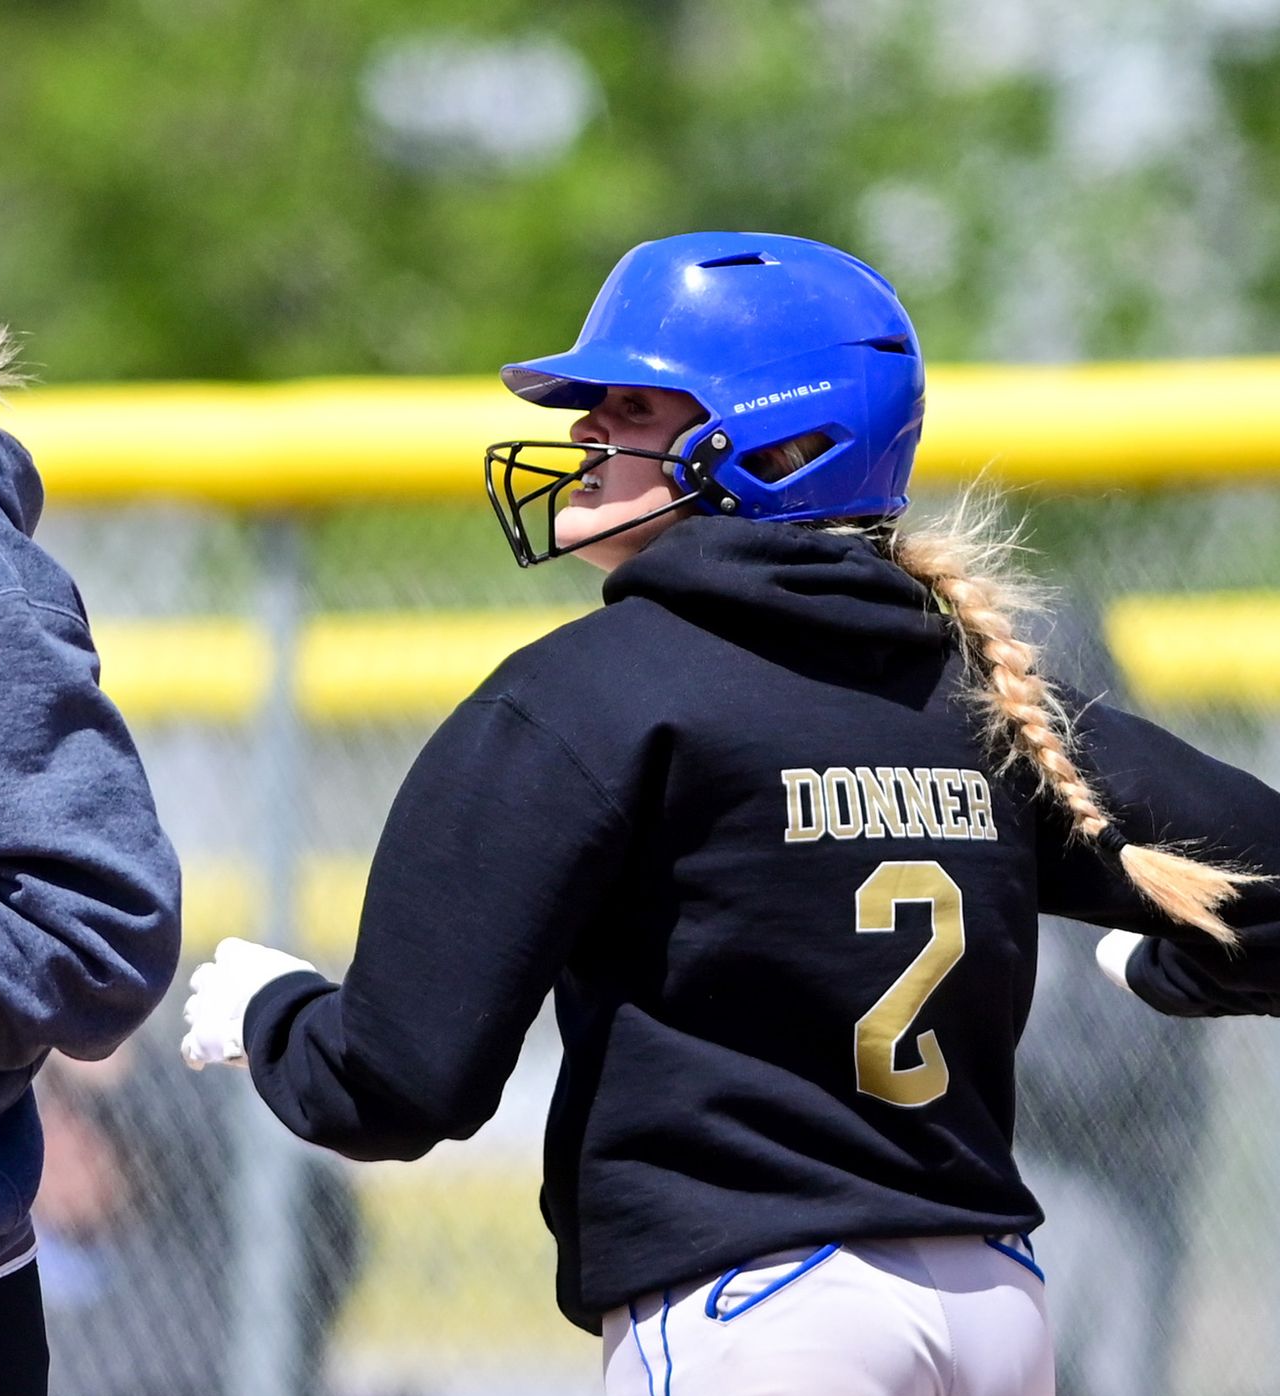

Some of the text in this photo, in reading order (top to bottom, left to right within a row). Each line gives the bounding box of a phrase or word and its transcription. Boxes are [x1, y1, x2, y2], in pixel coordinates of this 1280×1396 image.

[733, 381, 832, 414] EVOSHIELD
[781, 766, 998, 843] DONNER
[854, 860, 966, 1109] 2
